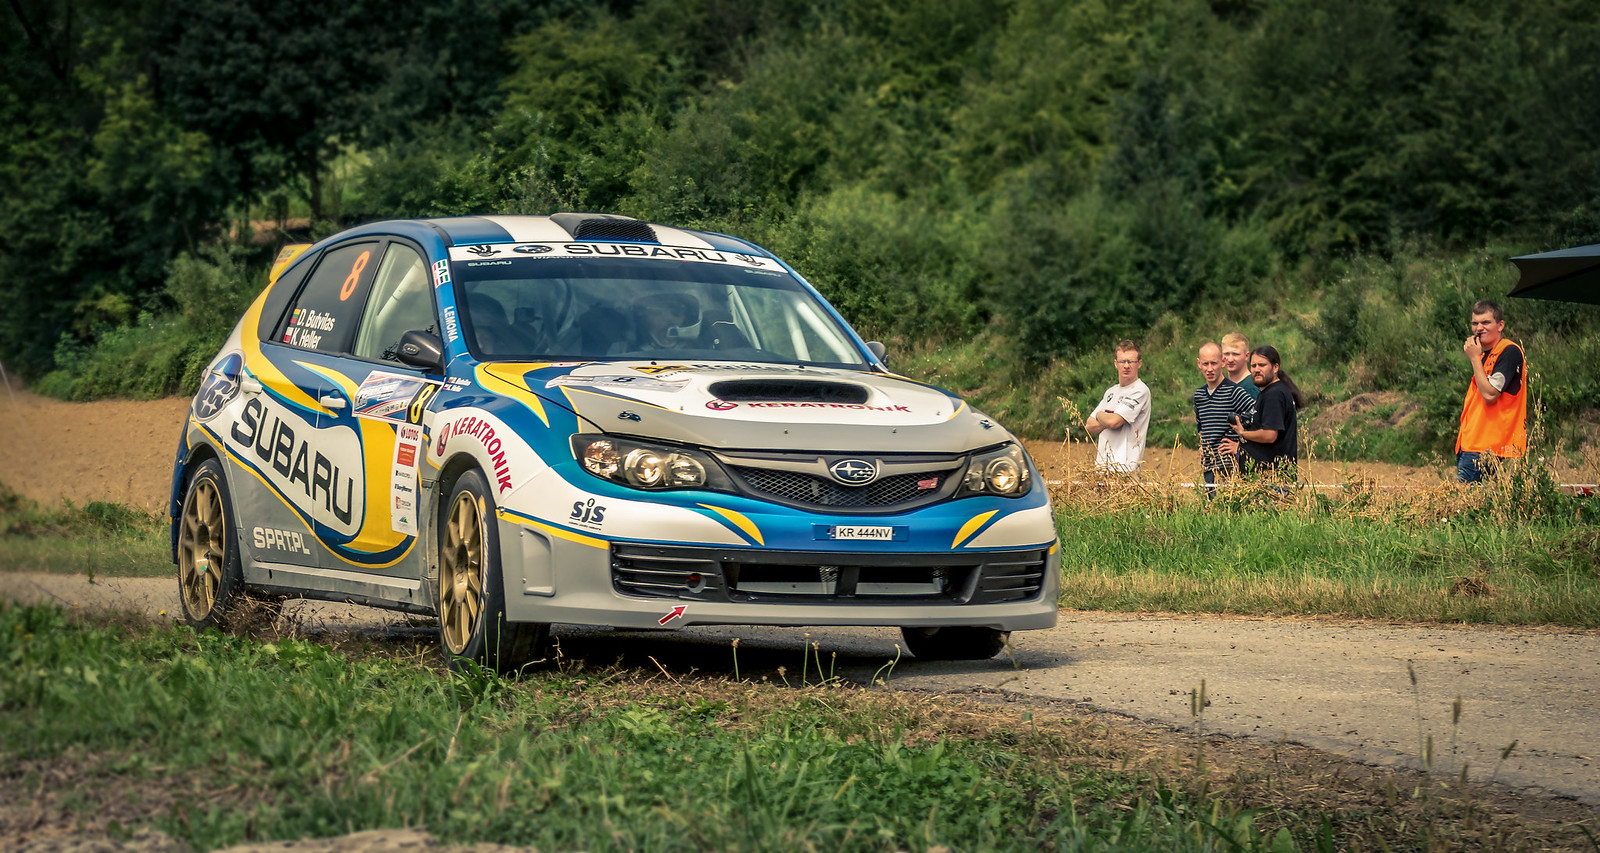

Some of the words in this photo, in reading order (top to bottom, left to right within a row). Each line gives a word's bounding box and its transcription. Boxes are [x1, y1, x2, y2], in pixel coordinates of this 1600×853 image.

[564, 244, 727, 262] SUBARU
[340, 251, 370, 301] 8
[297, 309, 305, 327] D.
[305, 310, 335, 332] Butvilas
[444, 306, 458, 342] LEMONA
[290, 328, 300, 346] K.
[299, 329, 322, 349] Heller
[410, 384, 435, 424] 8
[748, 402, 912, 413] KERATRONIK
[231, 397, 353, 526] SUBARU
[451, 416, 512, 495] KERATRONIK
[839, 528, 855, 537] KR
[857, 528, 890, 538] 444NV
